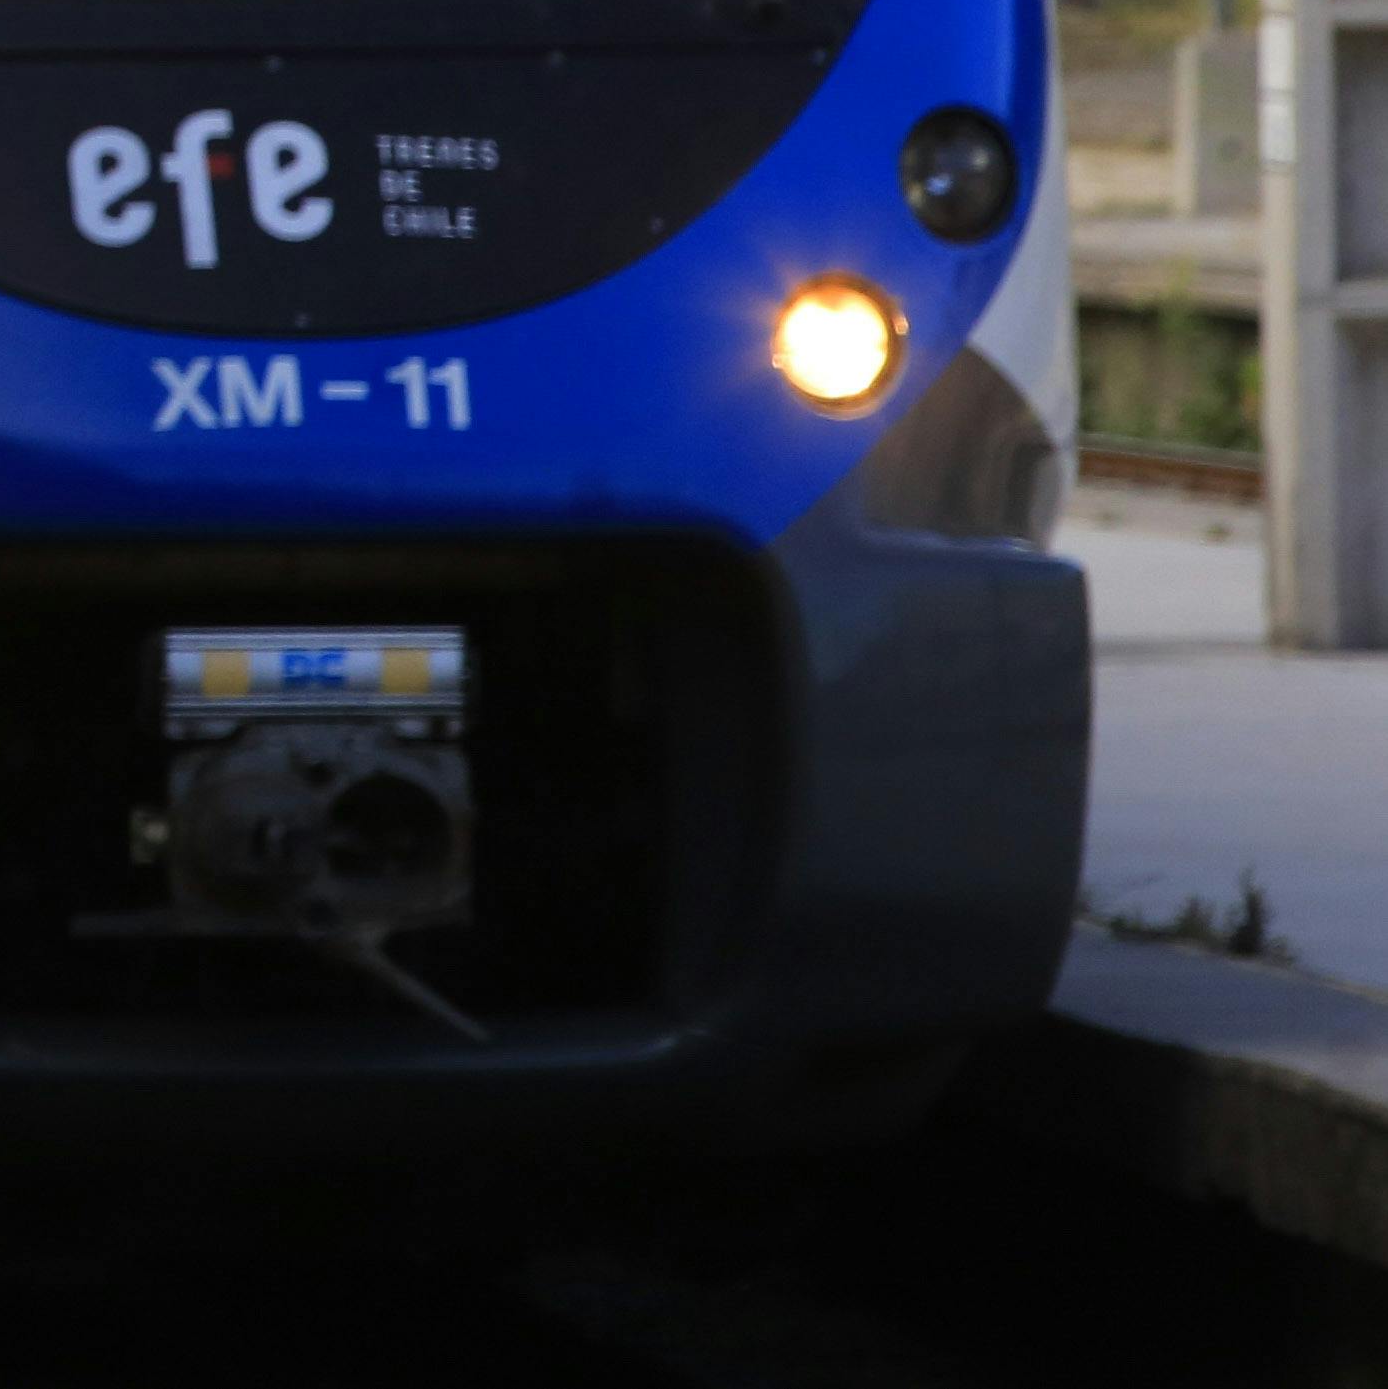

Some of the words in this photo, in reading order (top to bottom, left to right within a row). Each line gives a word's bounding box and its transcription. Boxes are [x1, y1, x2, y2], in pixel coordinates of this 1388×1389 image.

[375, 134, 500, 170] TRENES
[67, 108, 334, 269] efe
[379, 169, 423, 201] DE
[382, 205, 477, 238] CHILE
